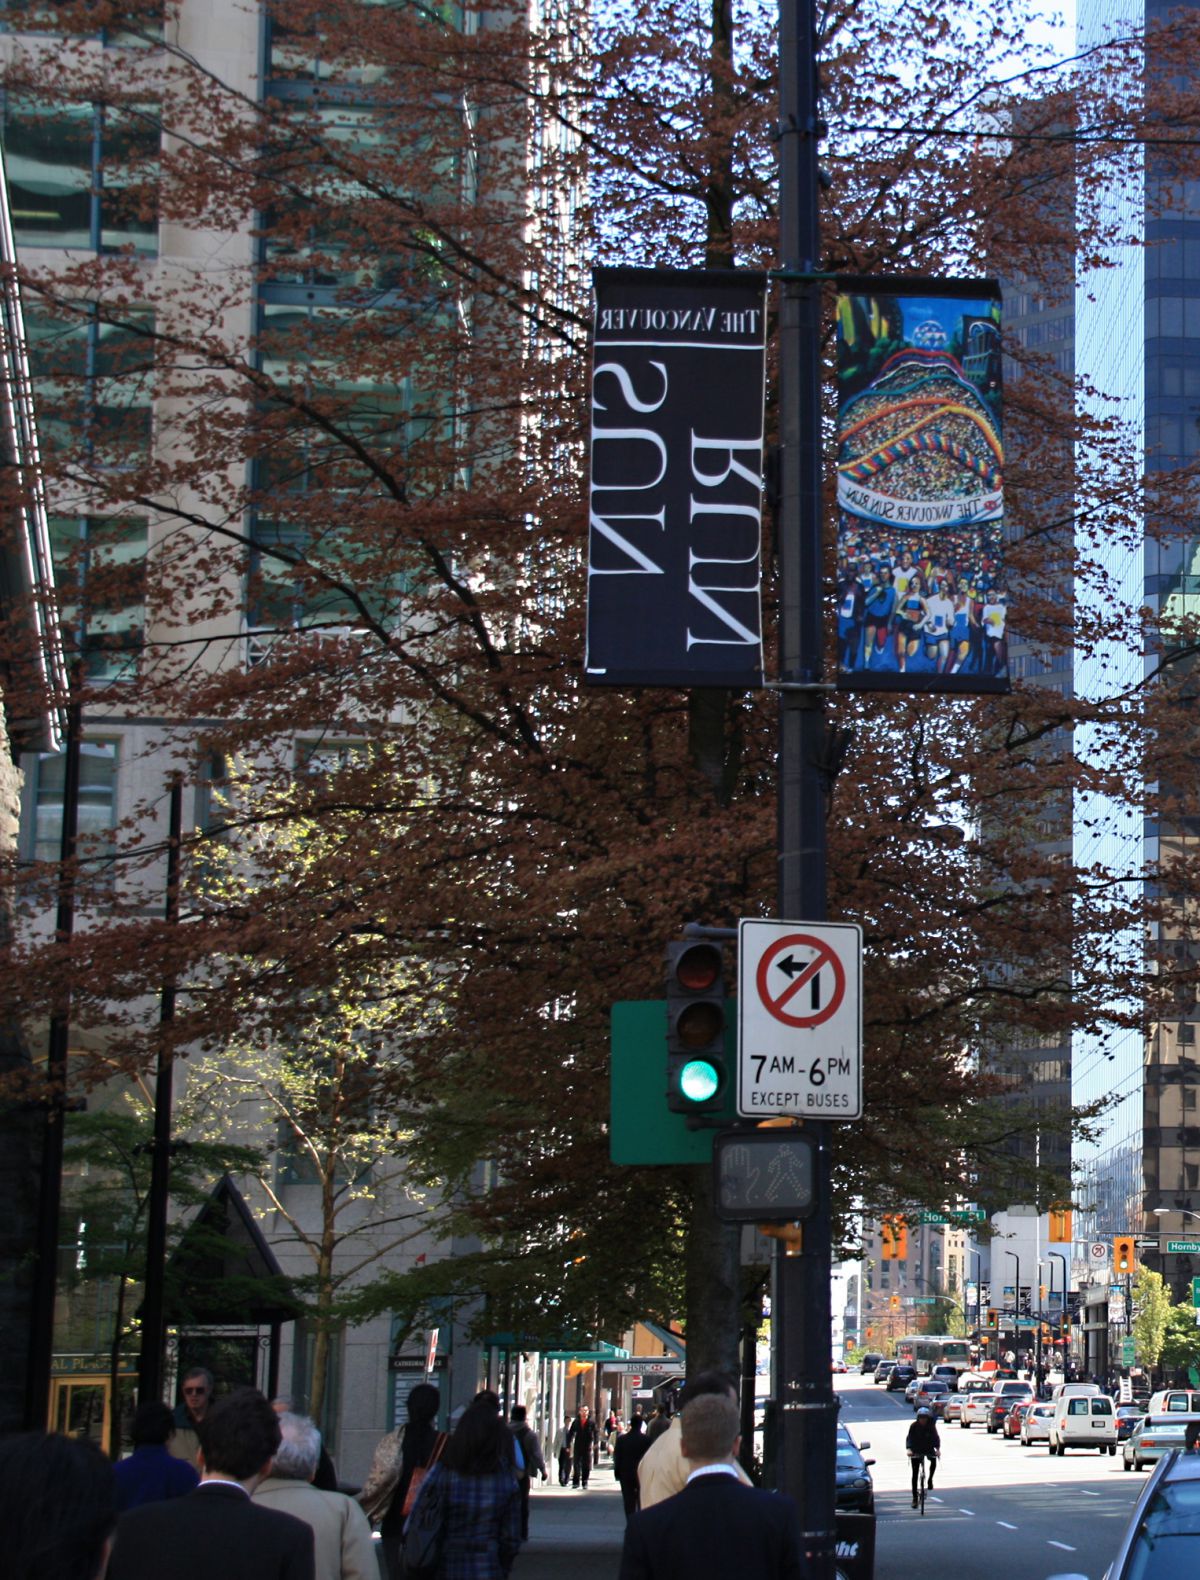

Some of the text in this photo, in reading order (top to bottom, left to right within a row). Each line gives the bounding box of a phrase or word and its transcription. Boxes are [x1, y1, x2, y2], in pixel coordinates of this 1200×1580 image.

[751, 1092, 849, 1108] EXCEPT BUSES
[627, 1364, 649, 1372] HSBC
